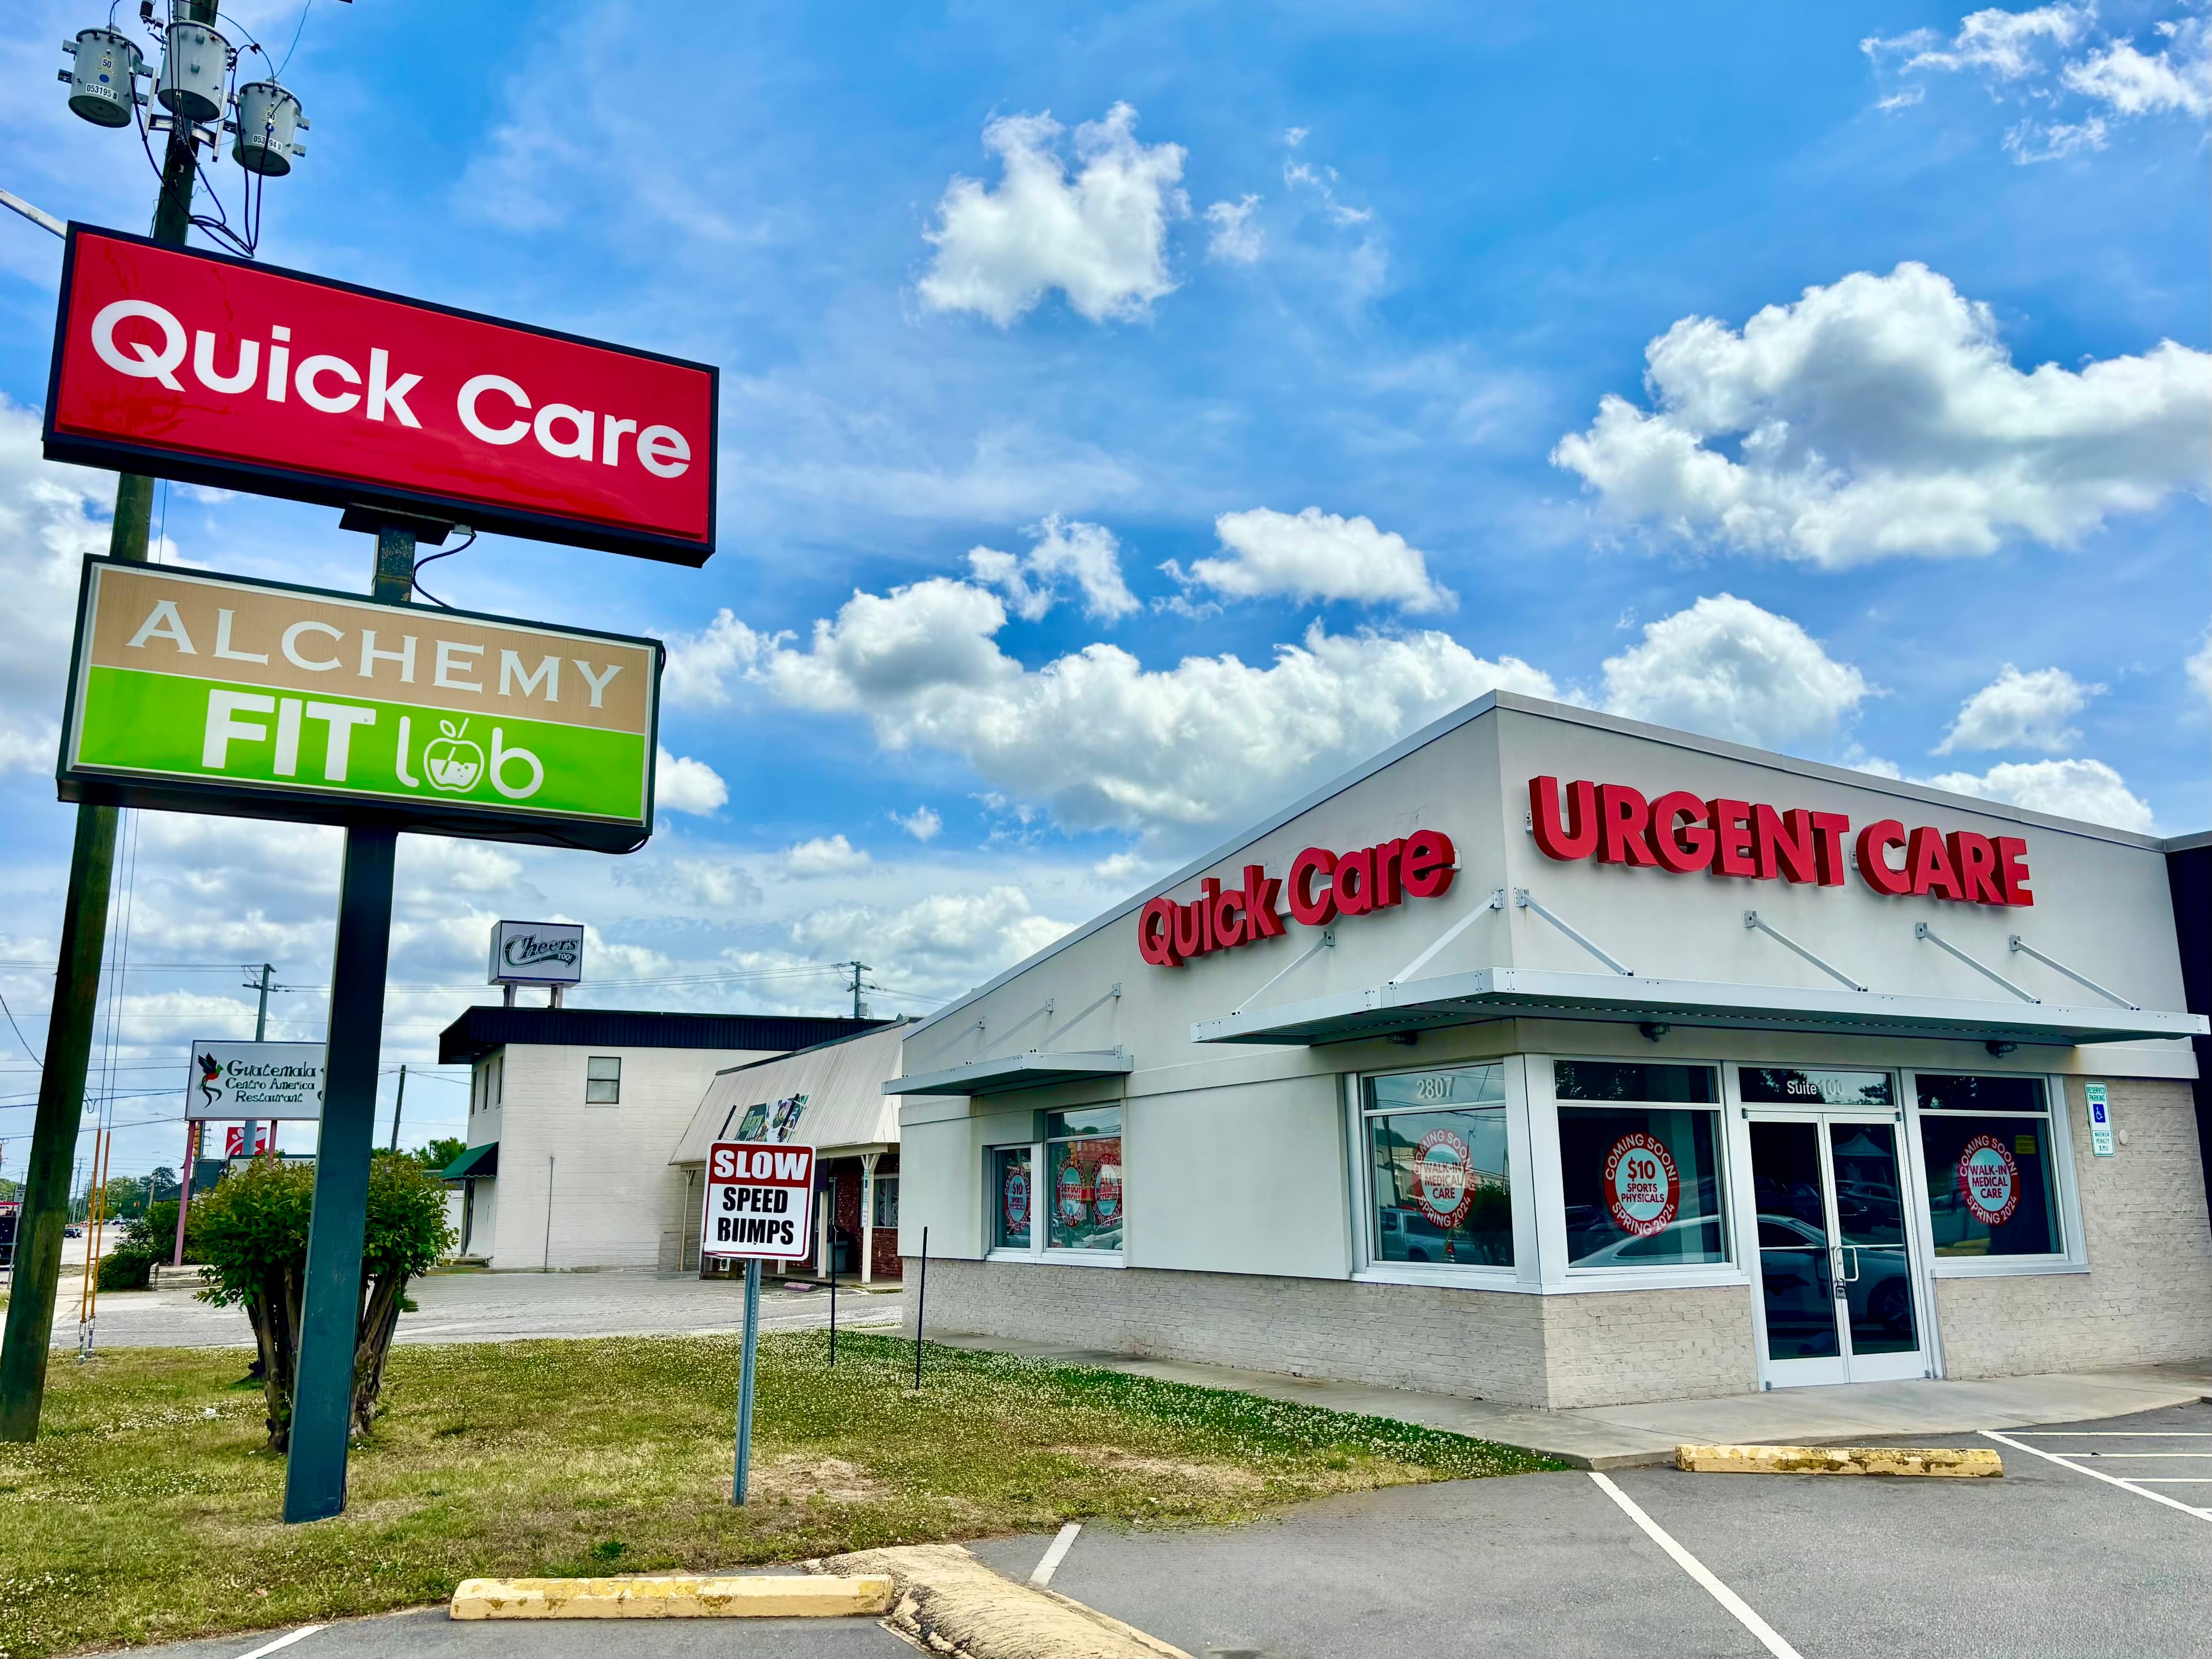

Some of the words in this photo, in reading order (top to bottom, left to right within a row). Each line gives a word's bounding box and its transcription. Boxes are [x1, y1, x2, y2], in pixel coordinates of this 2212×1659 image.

[103, 59, 112, 68] 50
[86, 84, 112, 97] 053195
[253, 135, 276, 148] 05394
[91, 300, 423, 429] Quick
[457, 374, 691, 478] Care
[126, 599, 624, 709] ALCHEMY
[202, 688, 377, 782] FIT
[1528, 775, 1850, 888] URGENT
[1855, 819, 2034, 908] CARE
[1138, 865, 1287, 968] Quick
[1288, 829, 1456, 926] Care
[503, 934, 579, 967] Cheers
[558, 953, 572, 962] TOO!
[226, 1059, 316, 1077] Guatemala
[225, 1077, 266, 1089] Centro
[270, 1078, 315, 1090] America
[1416, 1076, 1456, 1099] 2807
[1787, 1080, 1817, 1095] Suite
[234, 1090, 304, 1103] Restaurant
[1414, 1130, 1445, 1175] COMING
[1605, 1134, 1644, 1180] COMING
[1647, 1137, 1678, 1181] SOON!
[1960, 1135, 1989, 1177] COMING
[1991, 1138, 2018, 1176] SOON!
[714, 1149, 809, 1180] SLOW
[1423, 1161, 1461, 1173] WALK-IN
[1627, 1157, 1656, 1182] $10
[1969, 1165, 2008, 1176] WALK-IN
[1012, 1181, 1023, 1195] $10
[1425, 1174, 1463, 1187] MEDICAL
[1627, 1183, 1658, 1192] SPORTS
[1972, 1177, 2008, 1187] MEDICAL
[722, 1187, 789, 1214] SPEED
[1432, 1187, 1456, 1199] CARE
[1621, 1193, 1665, 1203] PHYSICALS
[1980, 1188, 2003, 1199] CARE
[1419, 1195, 1451, 1228] SPRING
[1452, 1196, 1471, 1224] 2024
[1612, 1201, 1652, 1235] SPRING
[1653, 1203, 1675, 1232] 2024
[1967, 1195, 2001, 1224] SPRING
[2001, 1196, 2017, 1221] 2024
[717, 1217, 794, 1245] BUMPS
